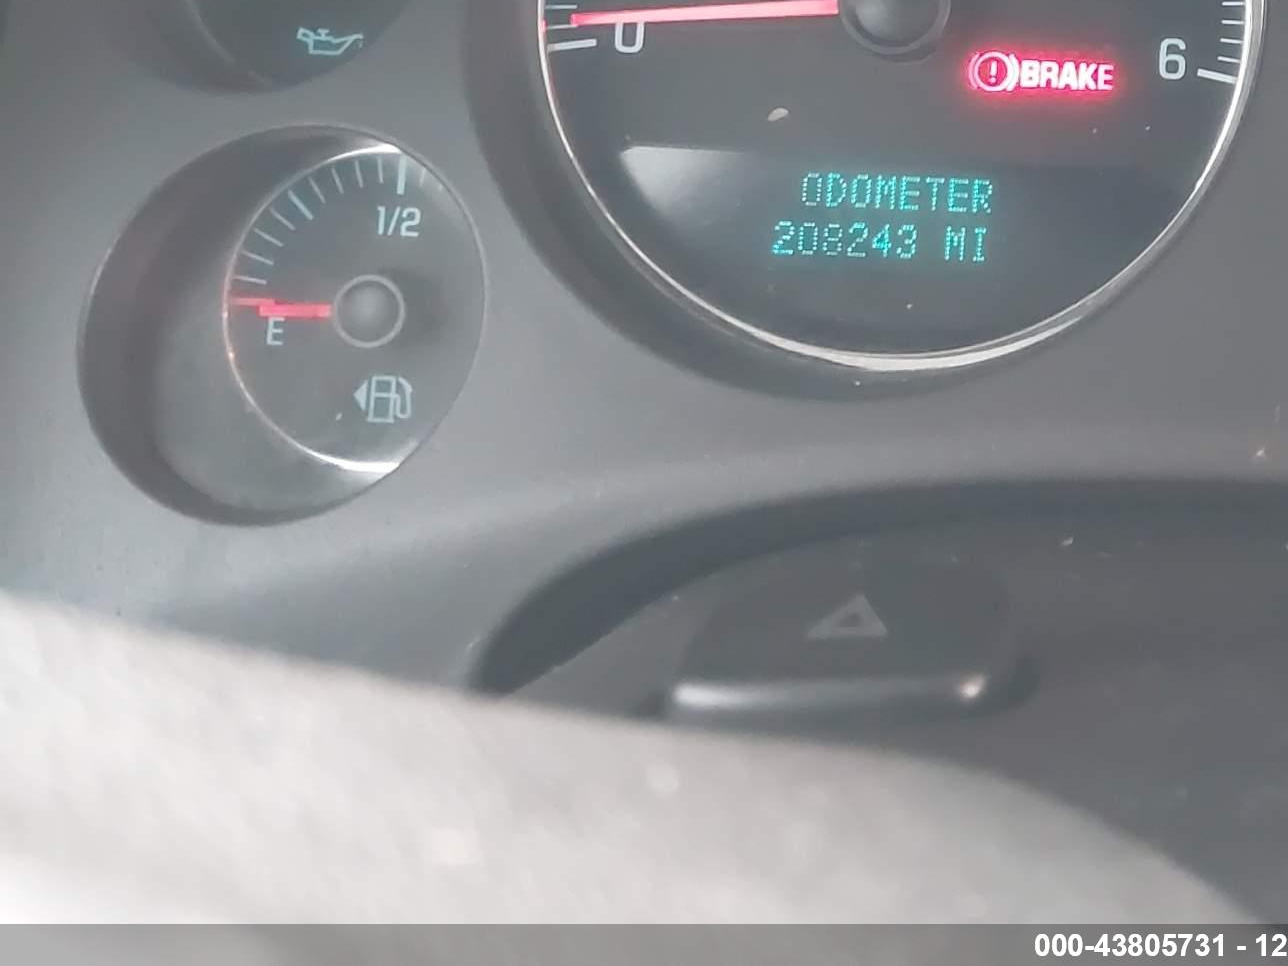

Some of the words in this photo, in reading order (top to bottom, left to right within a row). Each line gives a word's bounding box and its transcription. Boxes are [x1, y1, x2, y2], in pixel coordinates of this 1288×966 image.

[615, 21, 645, 53] 0
[1020, 60, 1114, 91] BRAKE
[1159, 38, 1186, 81] 6
[801, 172, 993, 214] ODOMETER
[375, 207, 420, 238] 1/2
[772, 220, 917, 259] 208243
[944, 225, 987, 262] MI
[267, 317, 284, 346] E
